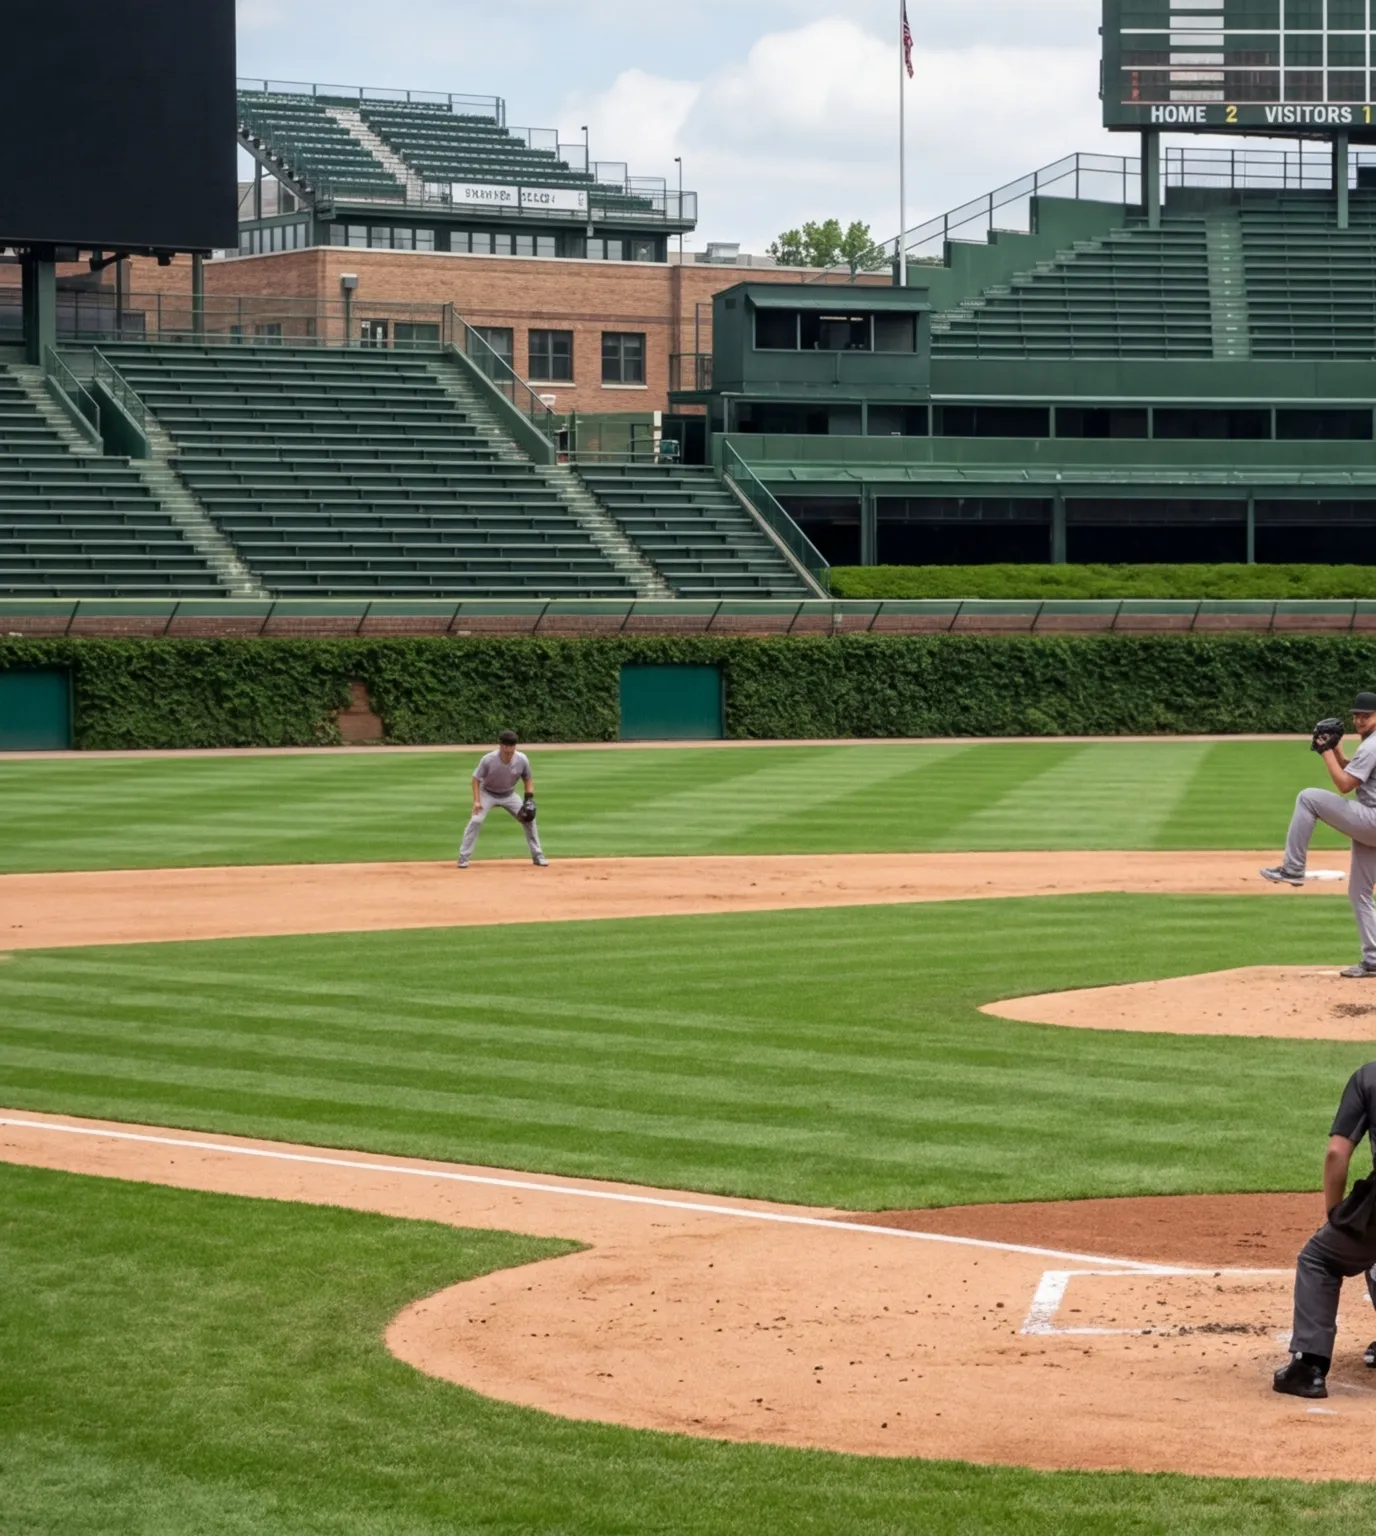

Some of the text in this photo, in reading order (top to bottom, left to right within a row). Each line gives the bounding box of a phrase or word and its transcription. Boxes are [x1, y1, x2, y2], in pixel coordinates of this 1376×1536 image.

[1151, 105, 1371, 124] HOME 2 VISITORS 1
